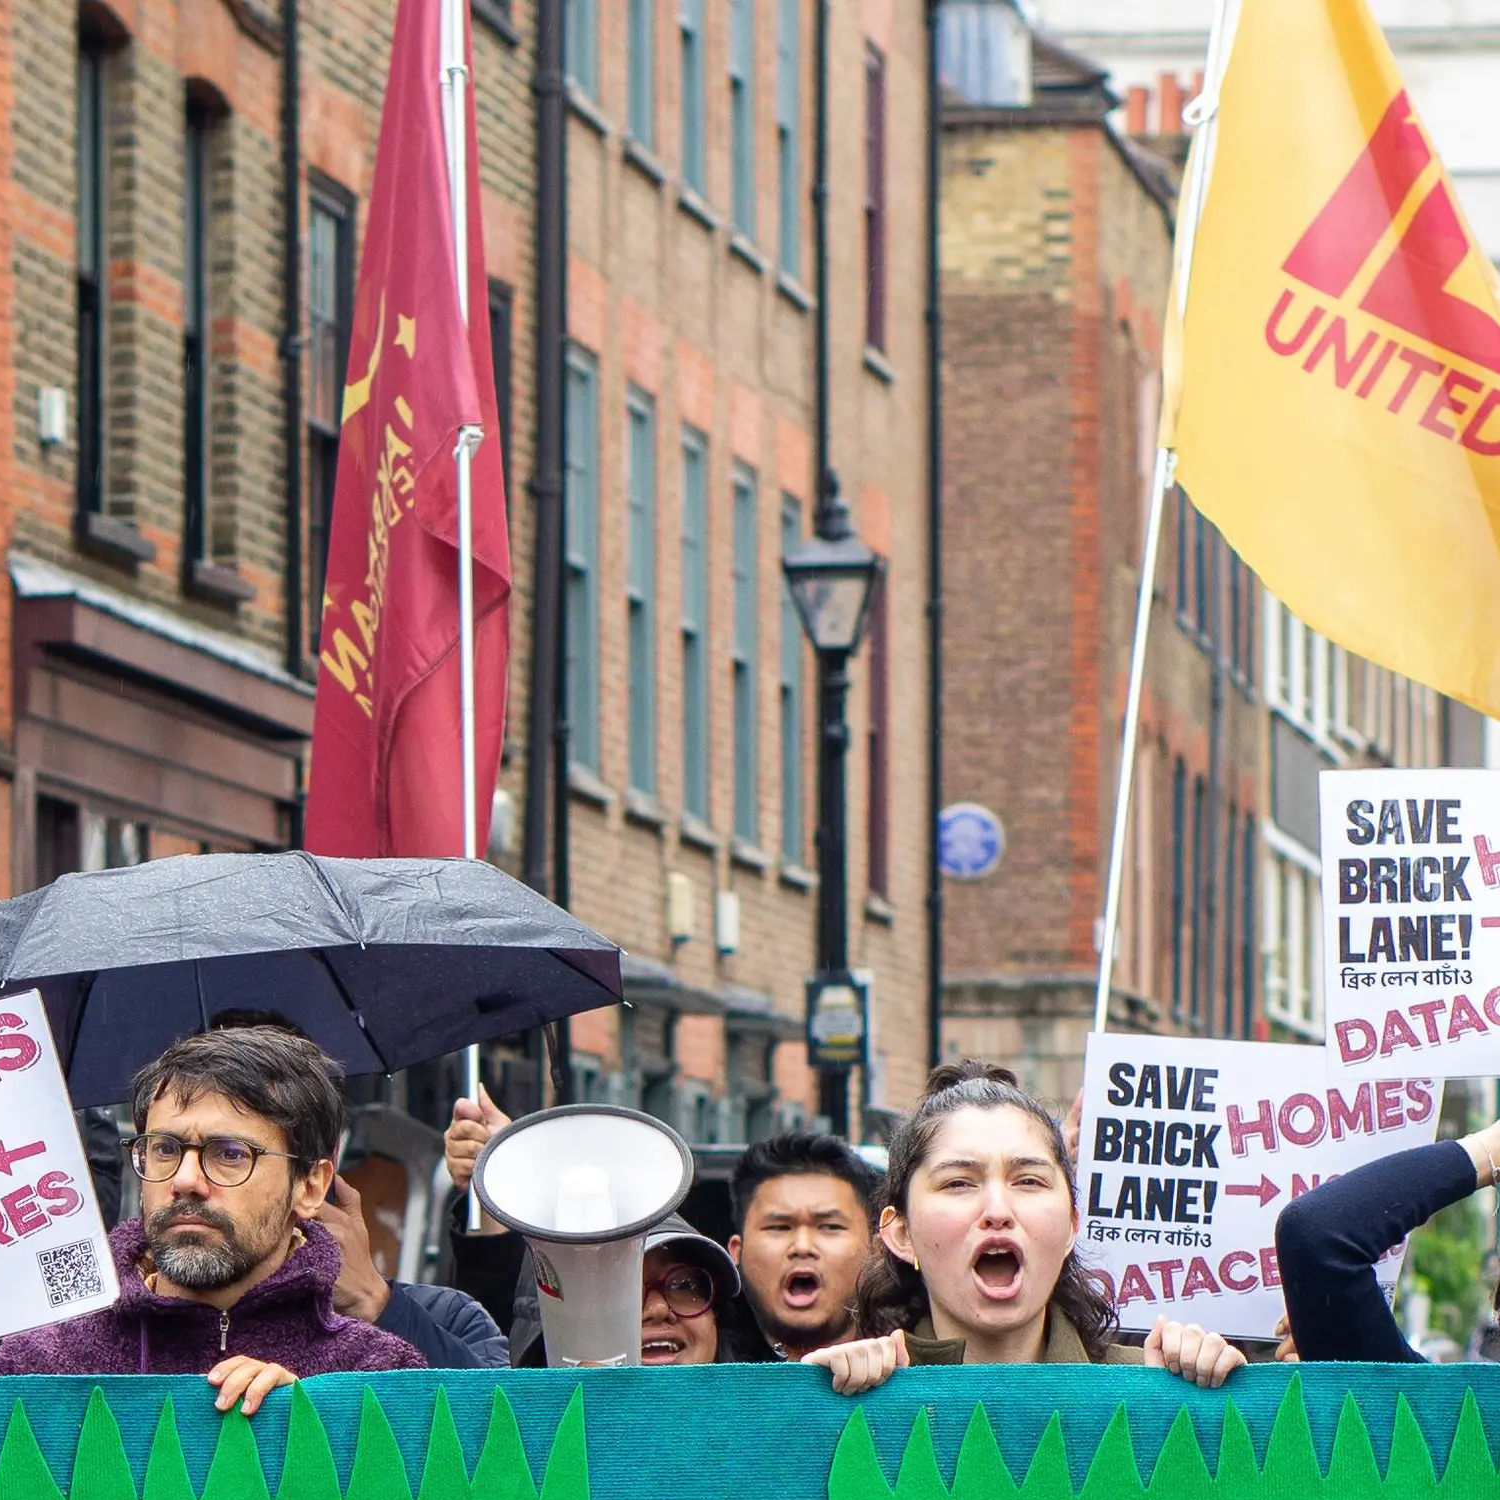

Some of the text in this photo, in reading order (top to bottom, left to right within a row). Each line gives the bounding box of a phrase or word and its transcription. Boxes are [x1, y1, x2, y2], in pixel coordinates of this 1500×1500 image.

[1345, 798, 1462, 845] SAVE
[1338, 856, 1472, 904] BRICK
[1338, 914, 1471, 963] LANE!
[1381, 970, 1418, 986] লেন
[1107, 1062, 1219, 1112] SAVE
[1225, 1078, 1434, 1158] HOMES
[1093, 1117, 1222, 1169] BRICK
[1087, 1173, 1218, 1225] LANE!
[1125, 1228, 1161, 1245] লেন
[1085, 1247, 1282, 1309] DATACE
